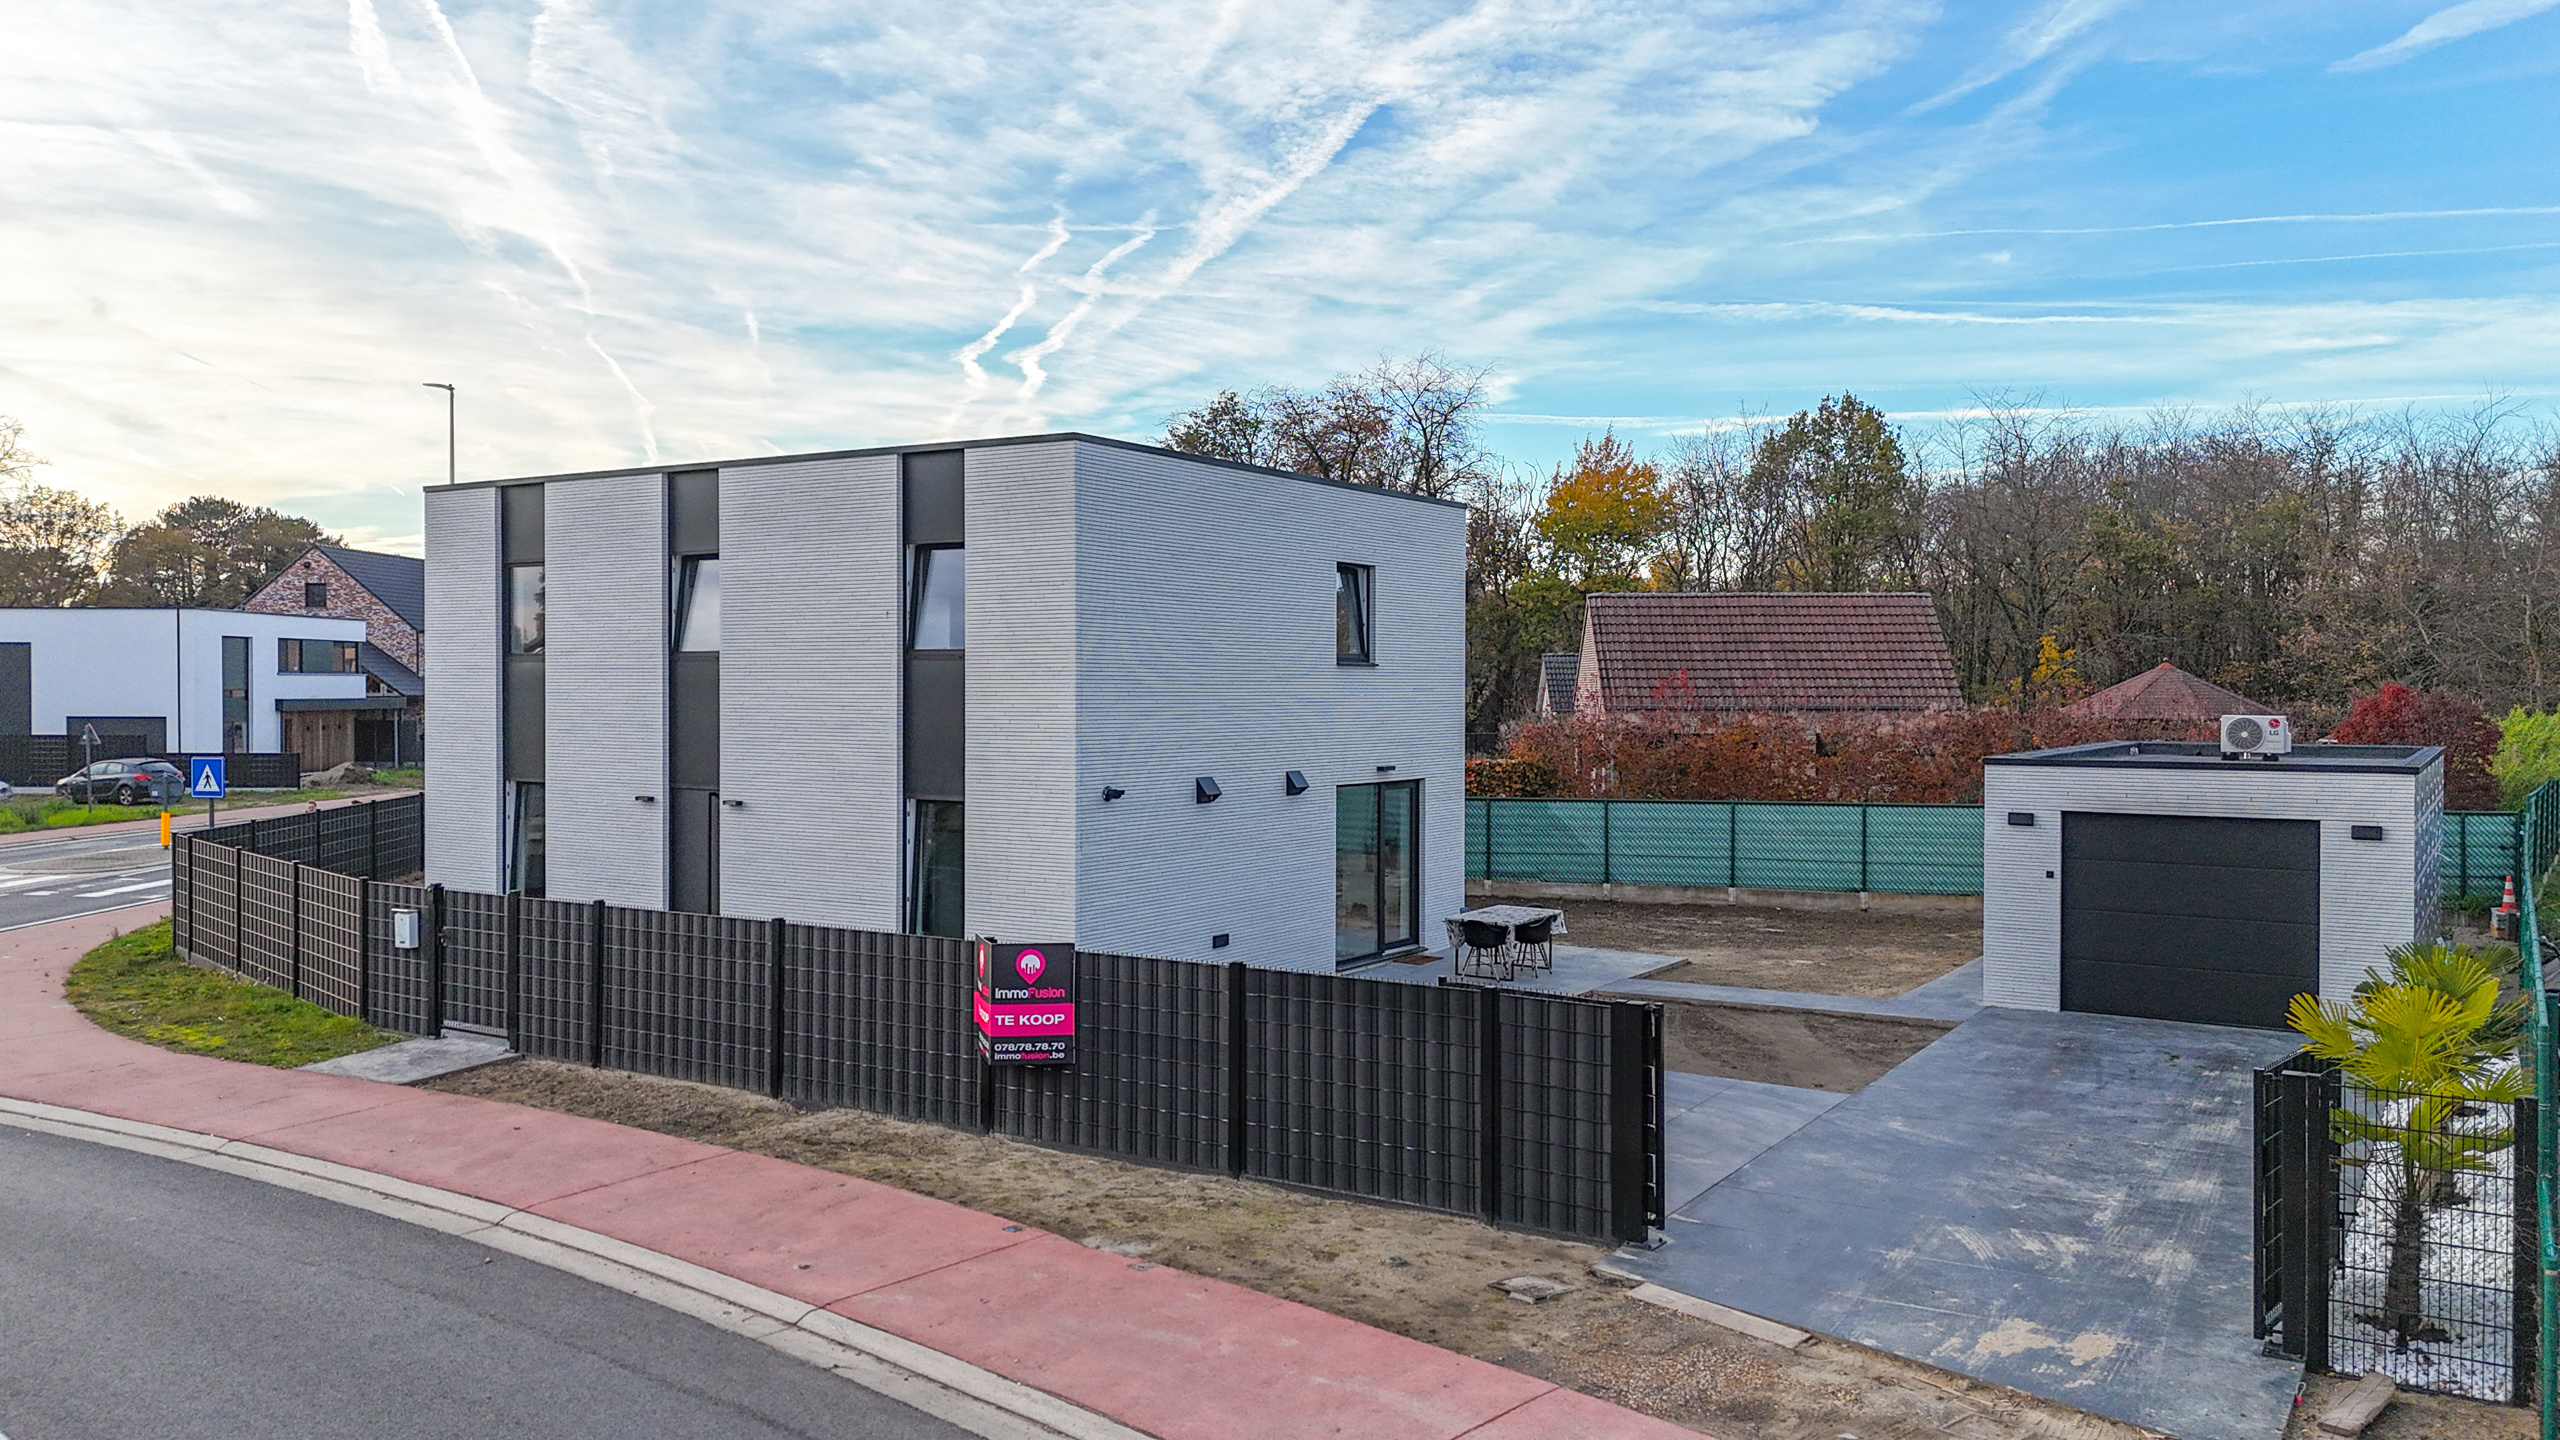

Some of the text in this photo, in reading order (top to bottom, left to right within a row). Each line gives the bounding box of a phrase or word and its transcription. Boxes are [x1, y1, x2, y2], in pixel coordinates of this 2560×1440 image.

[994, 1014, 1065, 1026] TE KOOP
[994, 1042, 1066, 1051] 078/78.78.70
[994, 1051, 1065, 1060] immofusion.be
